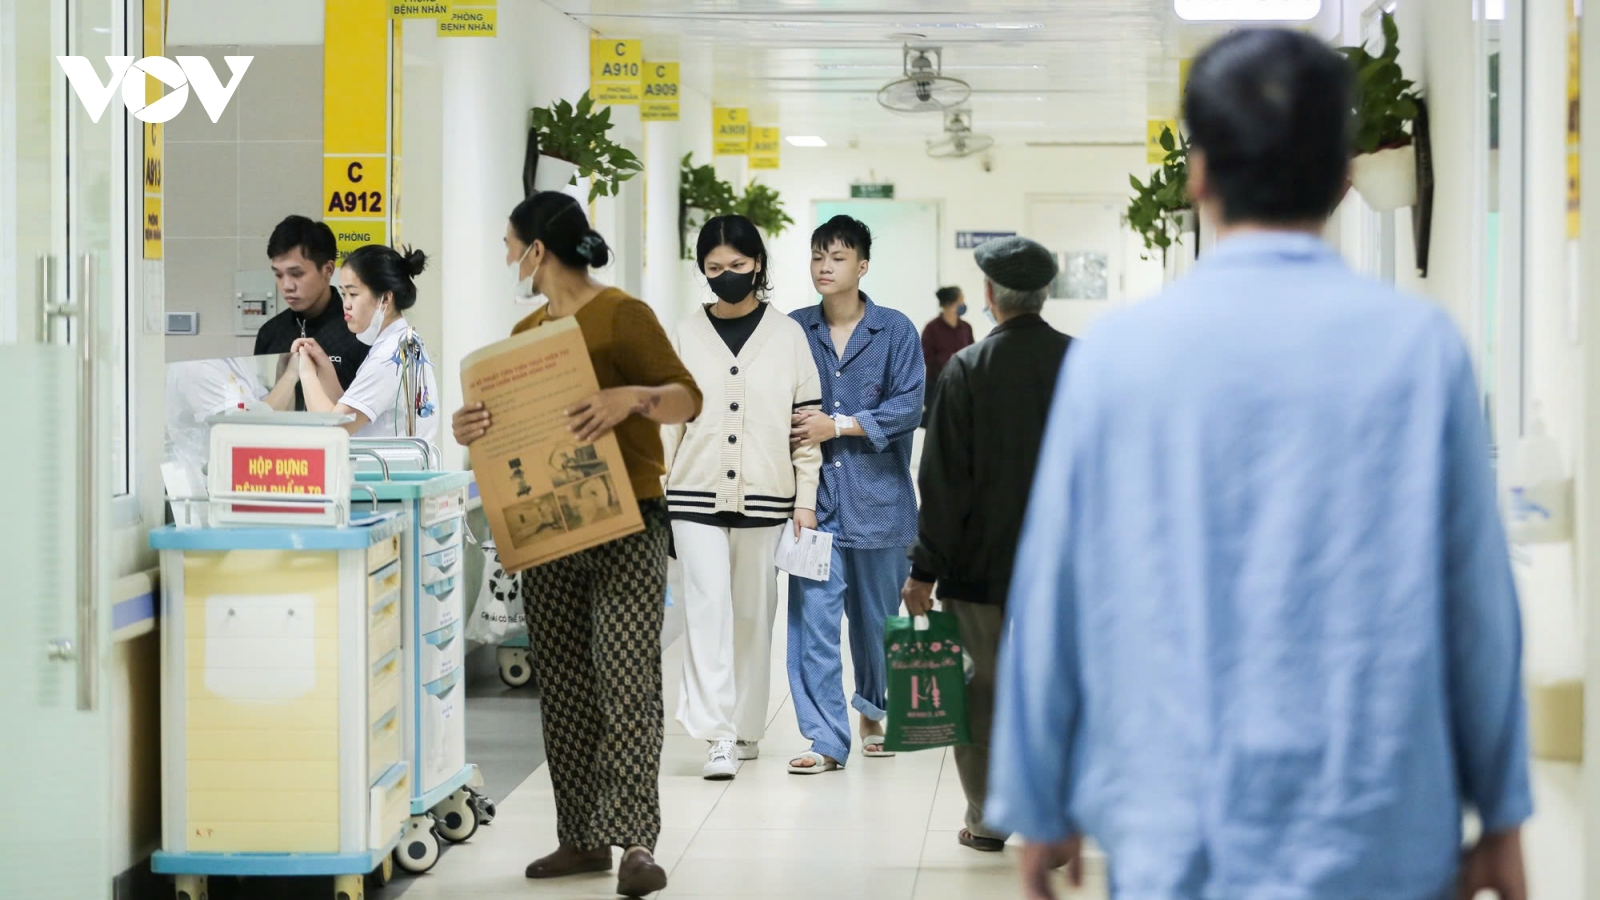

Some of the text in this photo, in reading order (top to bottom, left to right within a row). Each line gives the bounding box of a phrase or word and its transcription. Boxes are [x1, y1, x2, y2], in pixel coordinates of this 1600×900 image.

[394, 5, 446, 15] BỆNH NHÂN
[441, 22, 493, 32] BỆNH NHÂN
[615, 42, 626, 56] C
[602, 63, 639, 76] A910
[655, 65, 665, 78] C
[644, 84, 677, 96] A909
[728, 109, 737, 120] C
[347, 161, 363, 183] C
[328, 191, 382, 213] A912
[338, 230, 370, 242] PHÒNG
[249, 456, 308, 479] HỘP ĐỰNG
